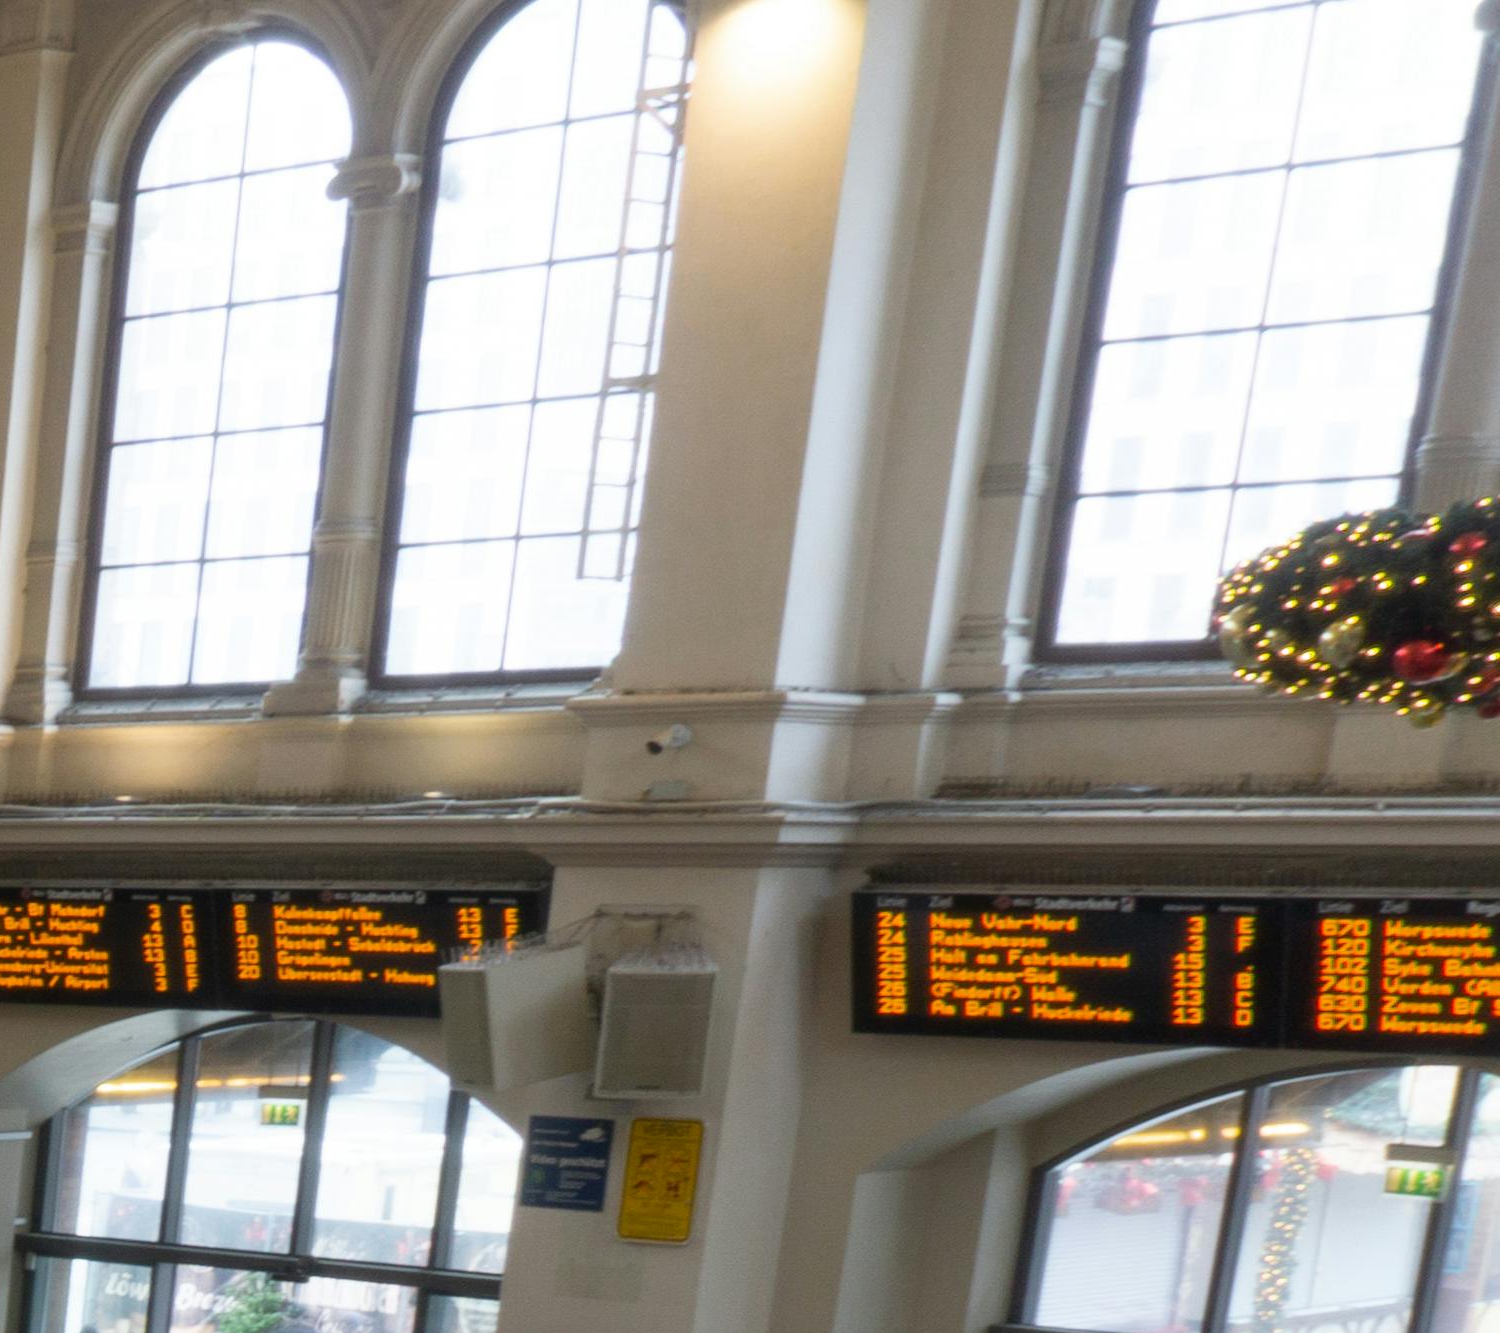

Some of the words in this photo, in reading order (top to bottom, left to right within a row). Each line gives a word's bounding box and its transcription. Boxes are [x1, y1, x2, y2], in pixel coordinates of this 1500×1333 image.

[148, 904, 161, 919] 3
[150, 920, 162, 933] 4
[876, 911, 907, 928] 24
[1186, 915, 1206, 934] 3
[1320, 918, 1371, 937] 670
[877, 928, 907, 945] 24
[1186, 934, 1206, 952] 3
[1320, 937, 1370, 957] 120
[1319, 956, 1369, 975] 102
[1318, 975, 1368, 993] 740
[1316, 1012, 1368, 1031] 670
